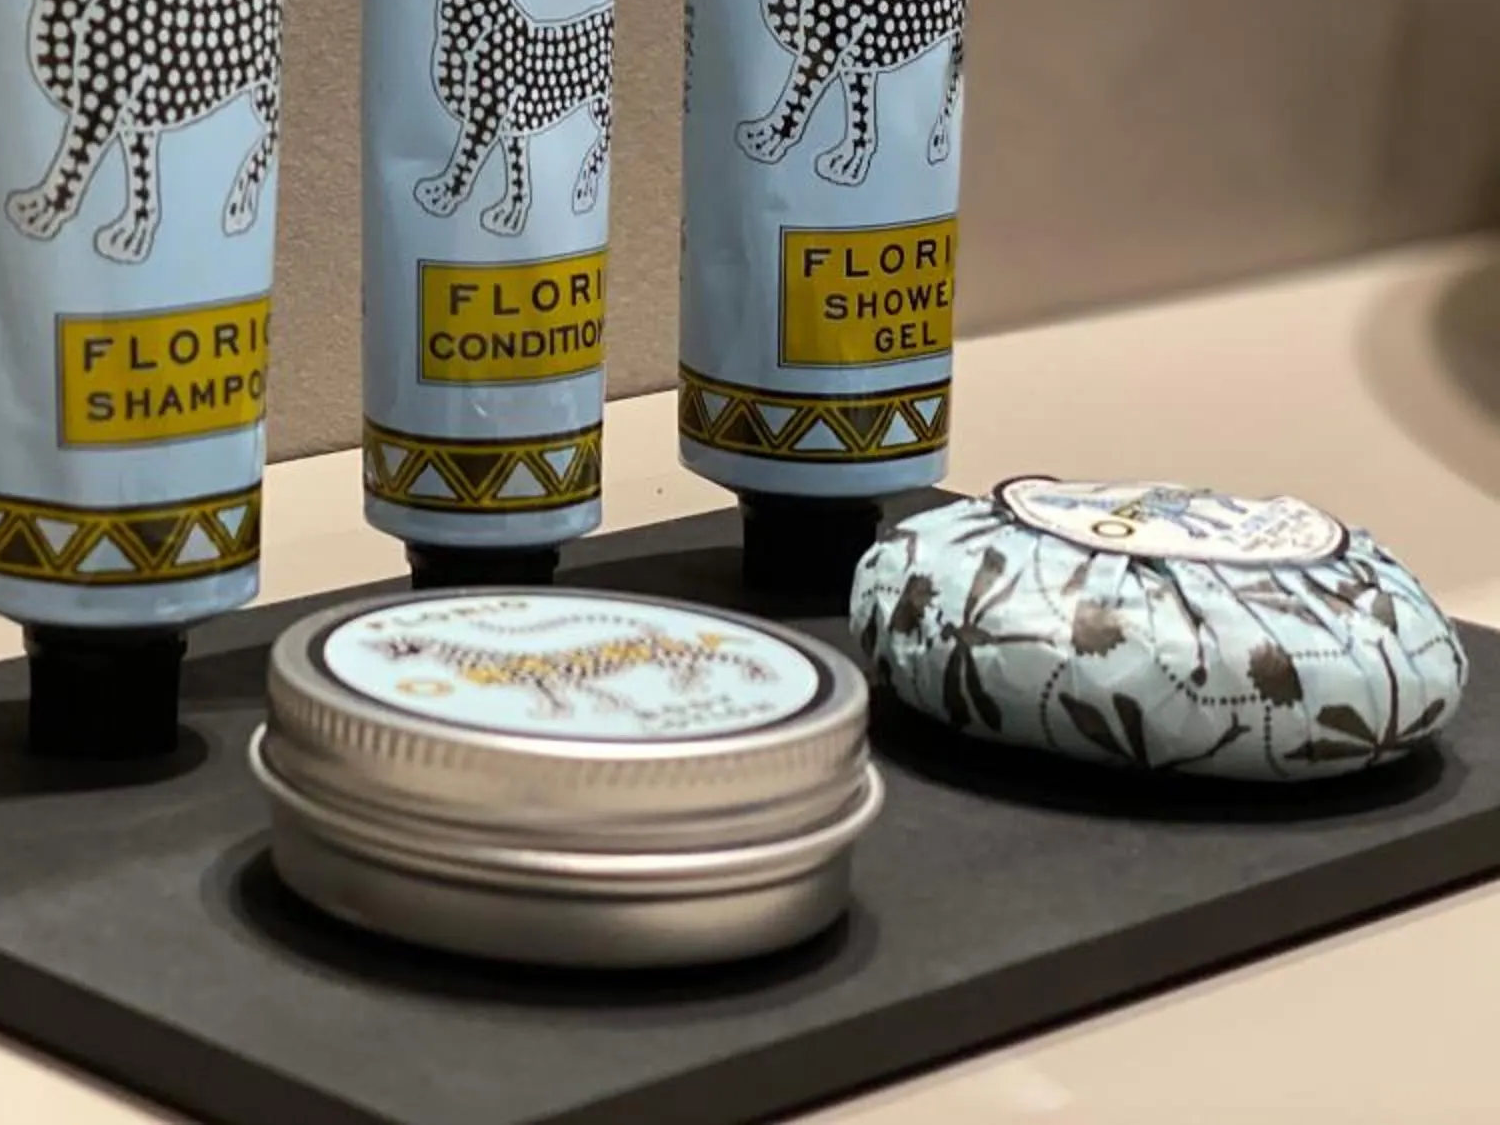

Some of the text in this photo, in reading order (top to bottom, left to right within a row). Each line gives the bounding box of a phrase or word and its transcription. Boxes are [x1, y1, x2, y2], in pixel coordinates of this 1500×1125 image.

[803, 235, 952, 277] FLORI
[449, 268, 602, 315] FLORI
[824, 278, 955, 320] SHOWE
[875, 321, 937, 353] GEL
[86, 365, 267, 421] SHAMPO
